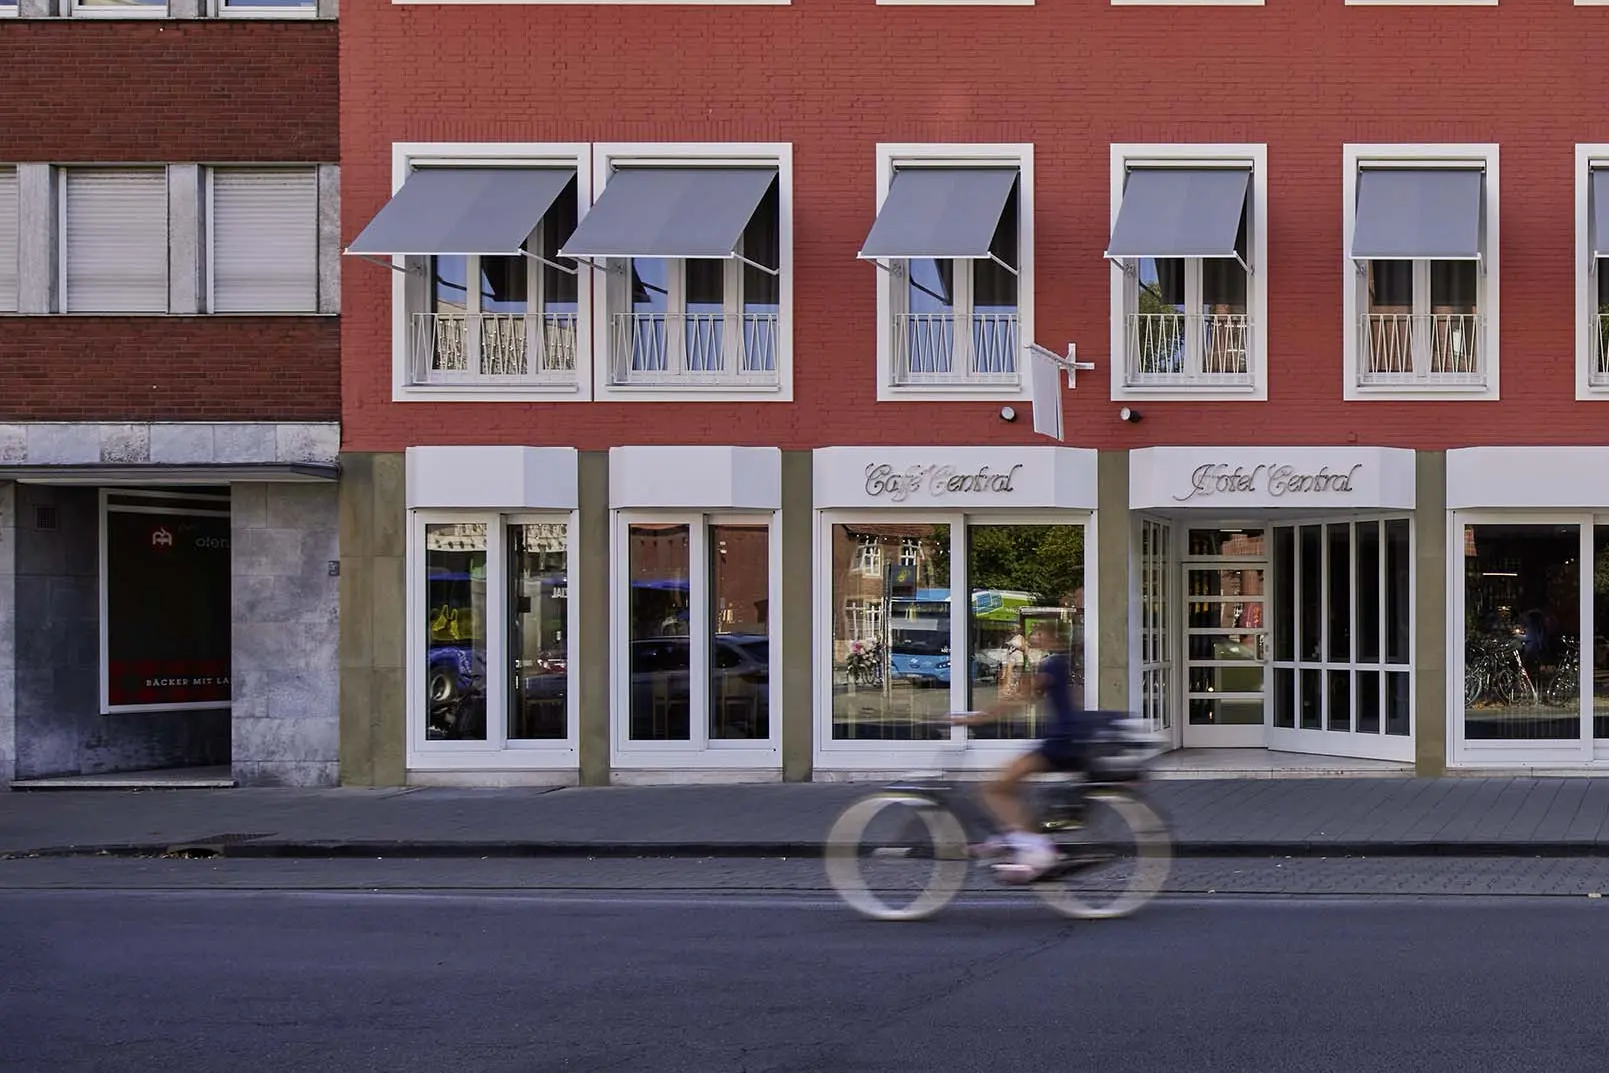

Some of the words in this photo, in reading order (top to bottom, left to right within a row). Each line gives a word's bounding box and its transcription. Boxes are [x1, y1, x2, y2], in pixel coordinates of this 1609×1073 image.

[927, 463, 1023, 497] Central
[1173, 463, 1265, 501] Hotel
[1267, 463, 1362, 497] Central
